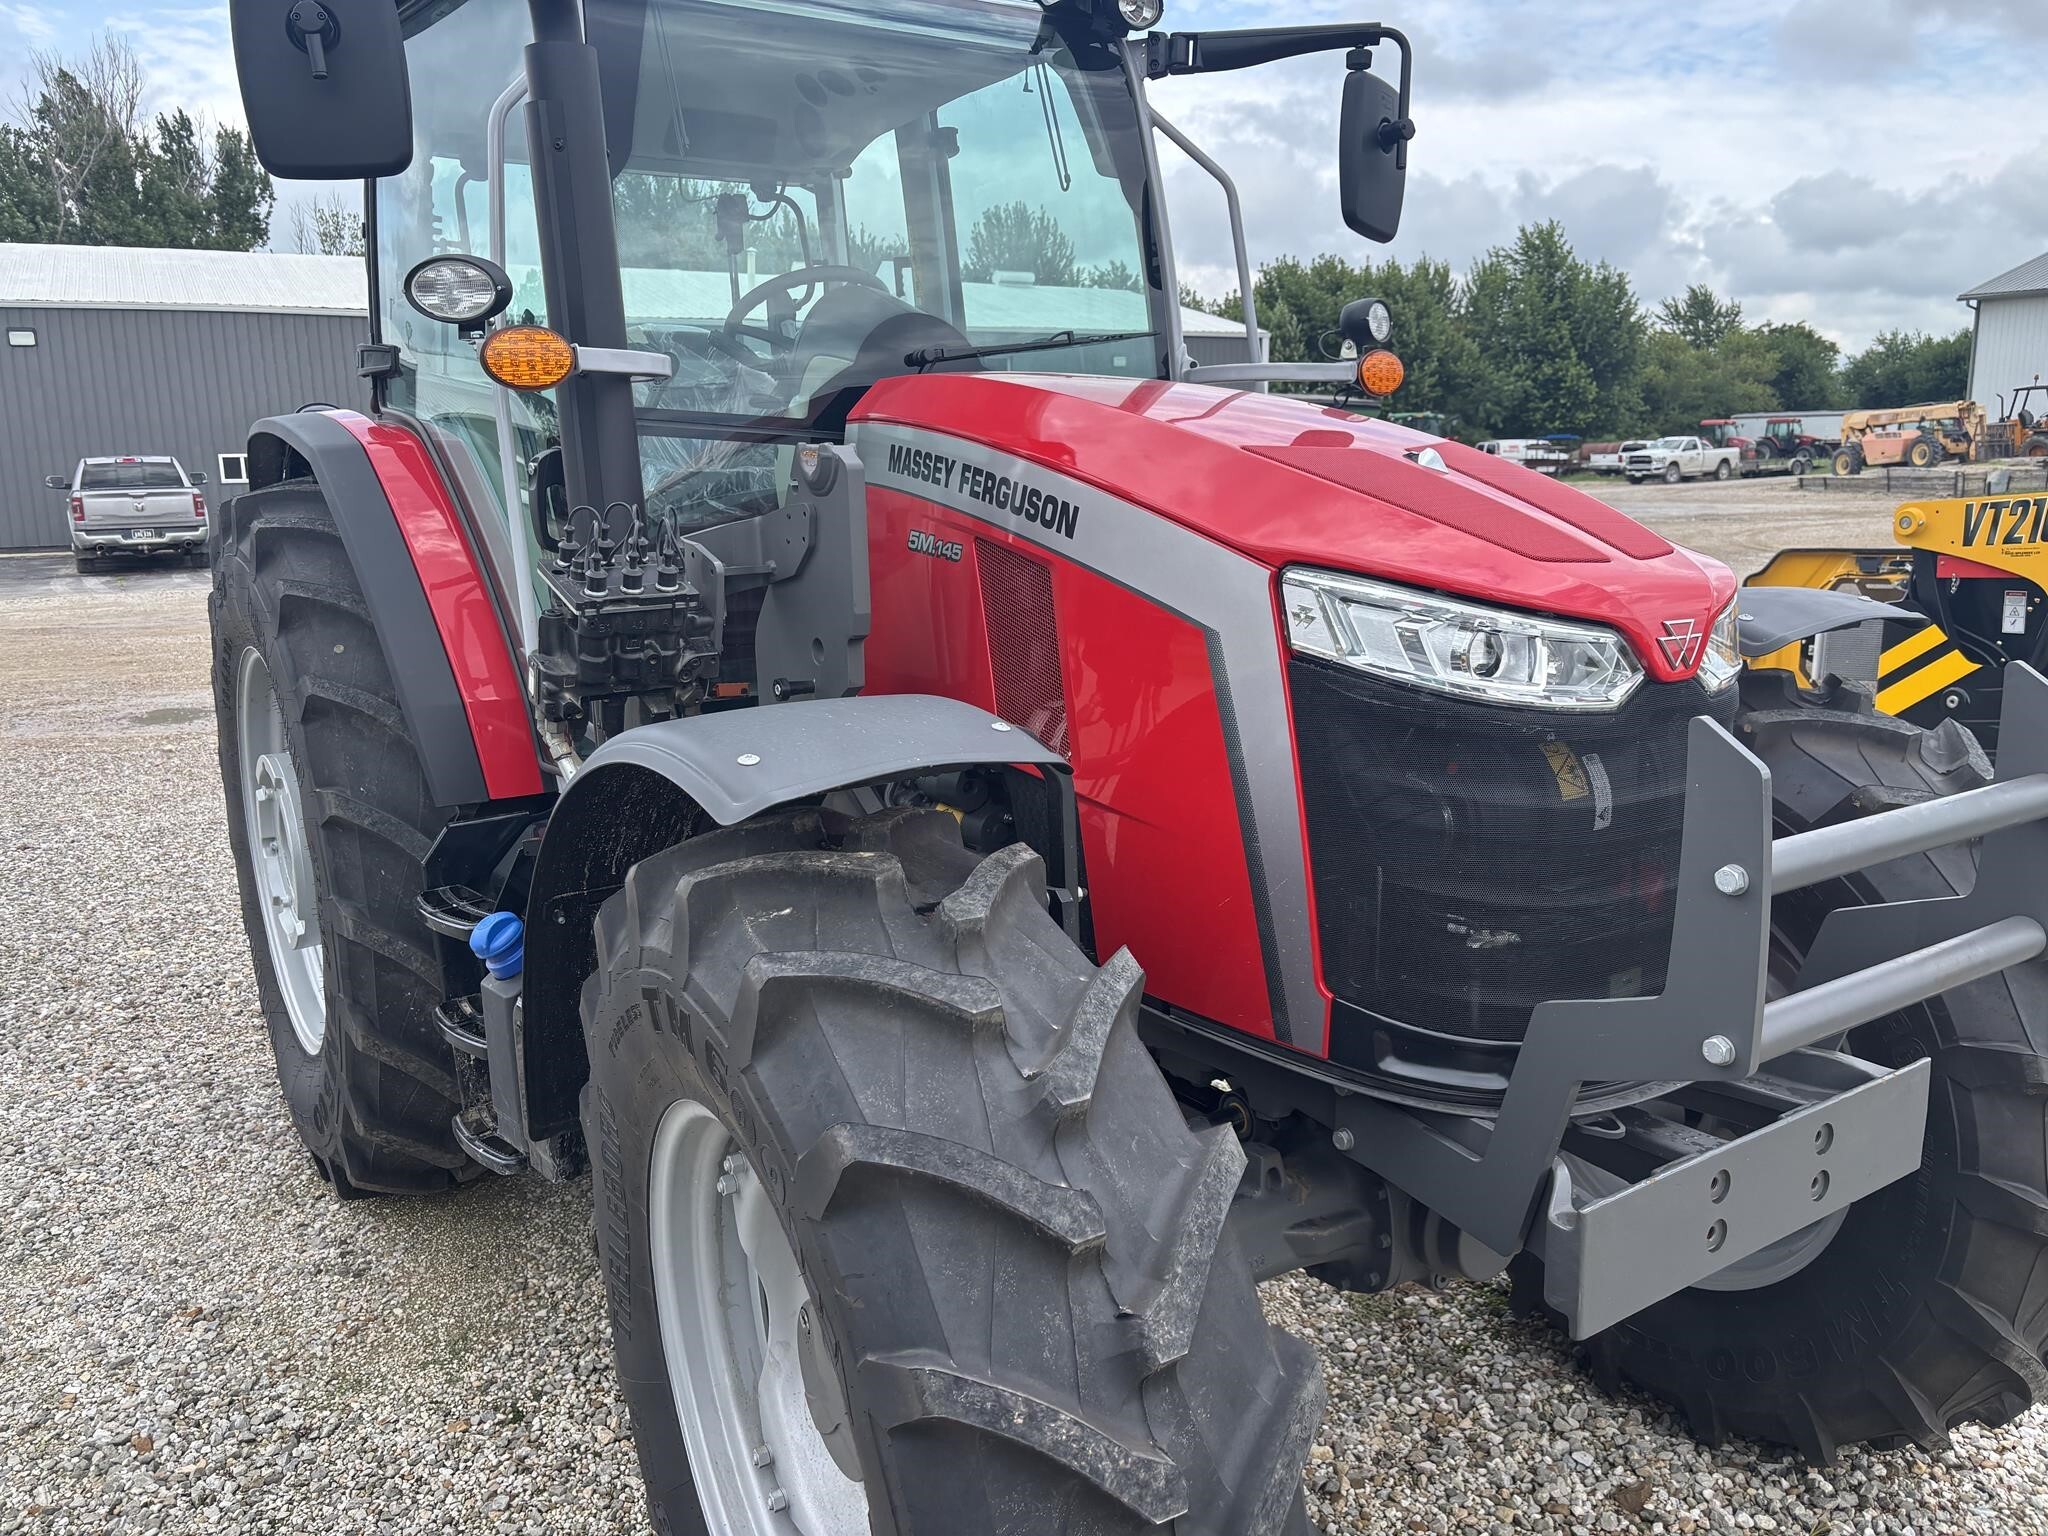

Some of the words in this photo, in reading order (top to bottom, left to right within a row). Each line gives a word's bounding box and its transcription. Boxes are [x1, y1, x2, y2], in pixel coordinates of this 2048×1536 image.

[888, 444, 956, 488] MASSEY
[958, 463, 1080, 540] FERGUSON
[907, 529, 963, 563] 5M.145
[598, 1085, 632, 1340] TRELLEBORG
